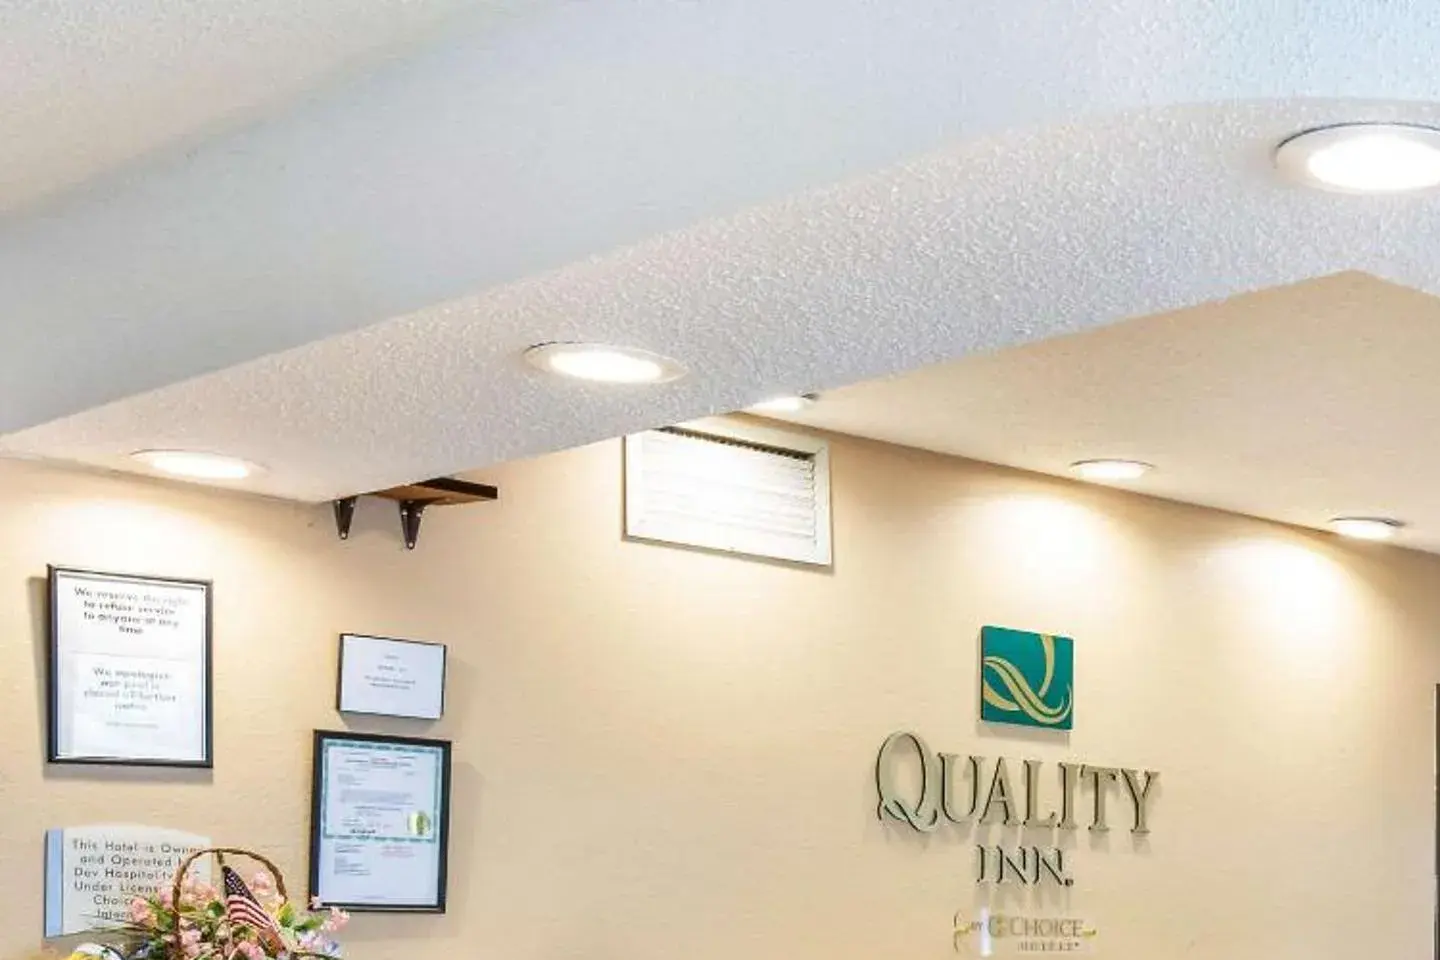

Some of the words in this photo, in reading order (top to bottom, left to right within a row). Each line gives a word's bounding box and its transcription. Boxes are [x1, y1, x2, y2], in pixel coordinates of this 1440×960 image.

[875, 731, 1160, 833] QUALITY
[73, 838, 98, 850] This
[104, 840, 138, 852] Hotel
[80, 855, 105, 865] and
[111, 855, 172, 867] Operated
[74, 880, 113, 891] Under
[119, 882, 160, 893] Licens
[1009, 917, 1084, 938] CHOICE
